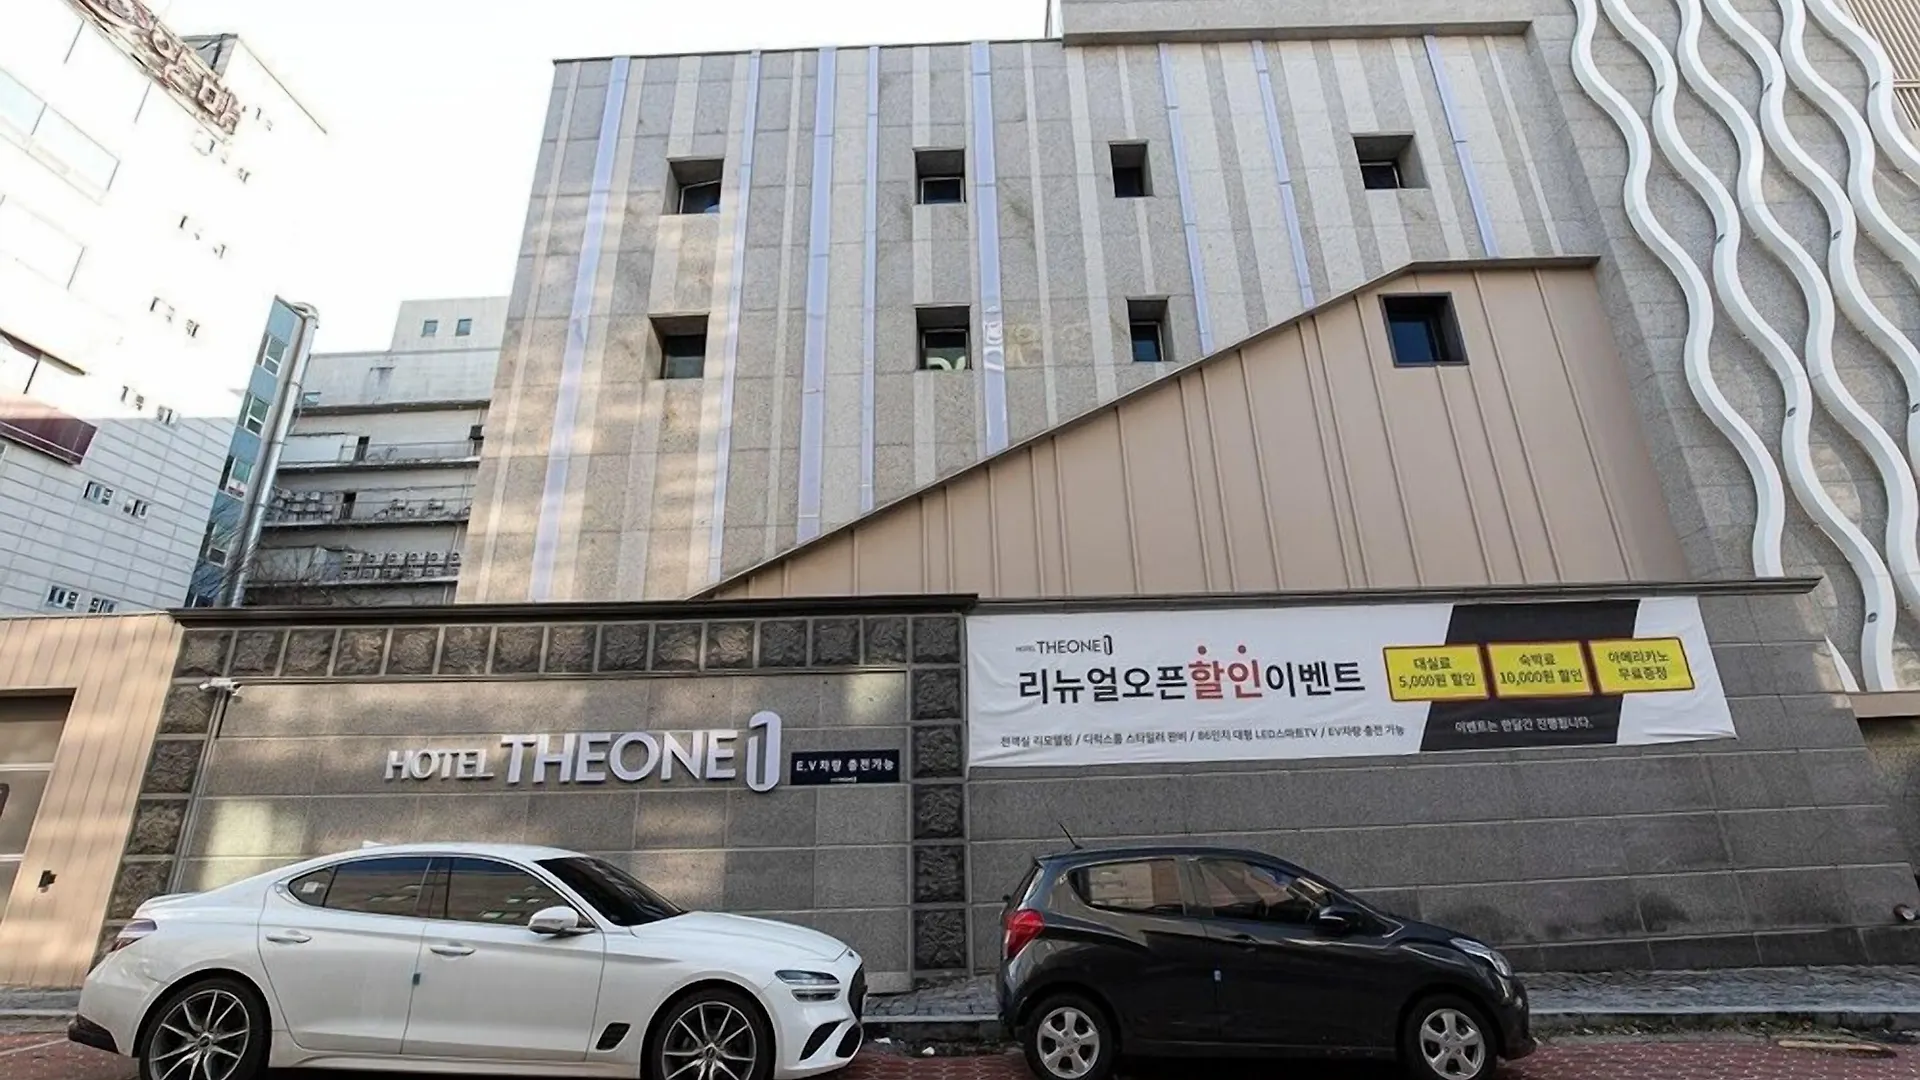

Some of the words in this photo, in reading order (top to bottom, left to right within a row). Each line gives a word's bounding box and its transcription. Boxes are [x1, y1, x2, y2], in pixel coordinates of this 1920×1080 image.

[1036, 640, 1101, 654] THEONE
[1413, 656, 1452, 671] 대실료
[1519, 653, 1556, 667] 숙박료
[1608, 648, 1670, 664] 아메리카노
[1399, 673, 1448, 689] 5,000원
[1451, 671, 1476, 687] 할인
[1500, 670, 1554, 687] 10,000원
[1558, 669, 1583, 684] 할인
[1618, 666, 1668, 680] 무료증정
[384, 748, 494, 781] HOTEL
[500, 729, 738, 784] THEONE
